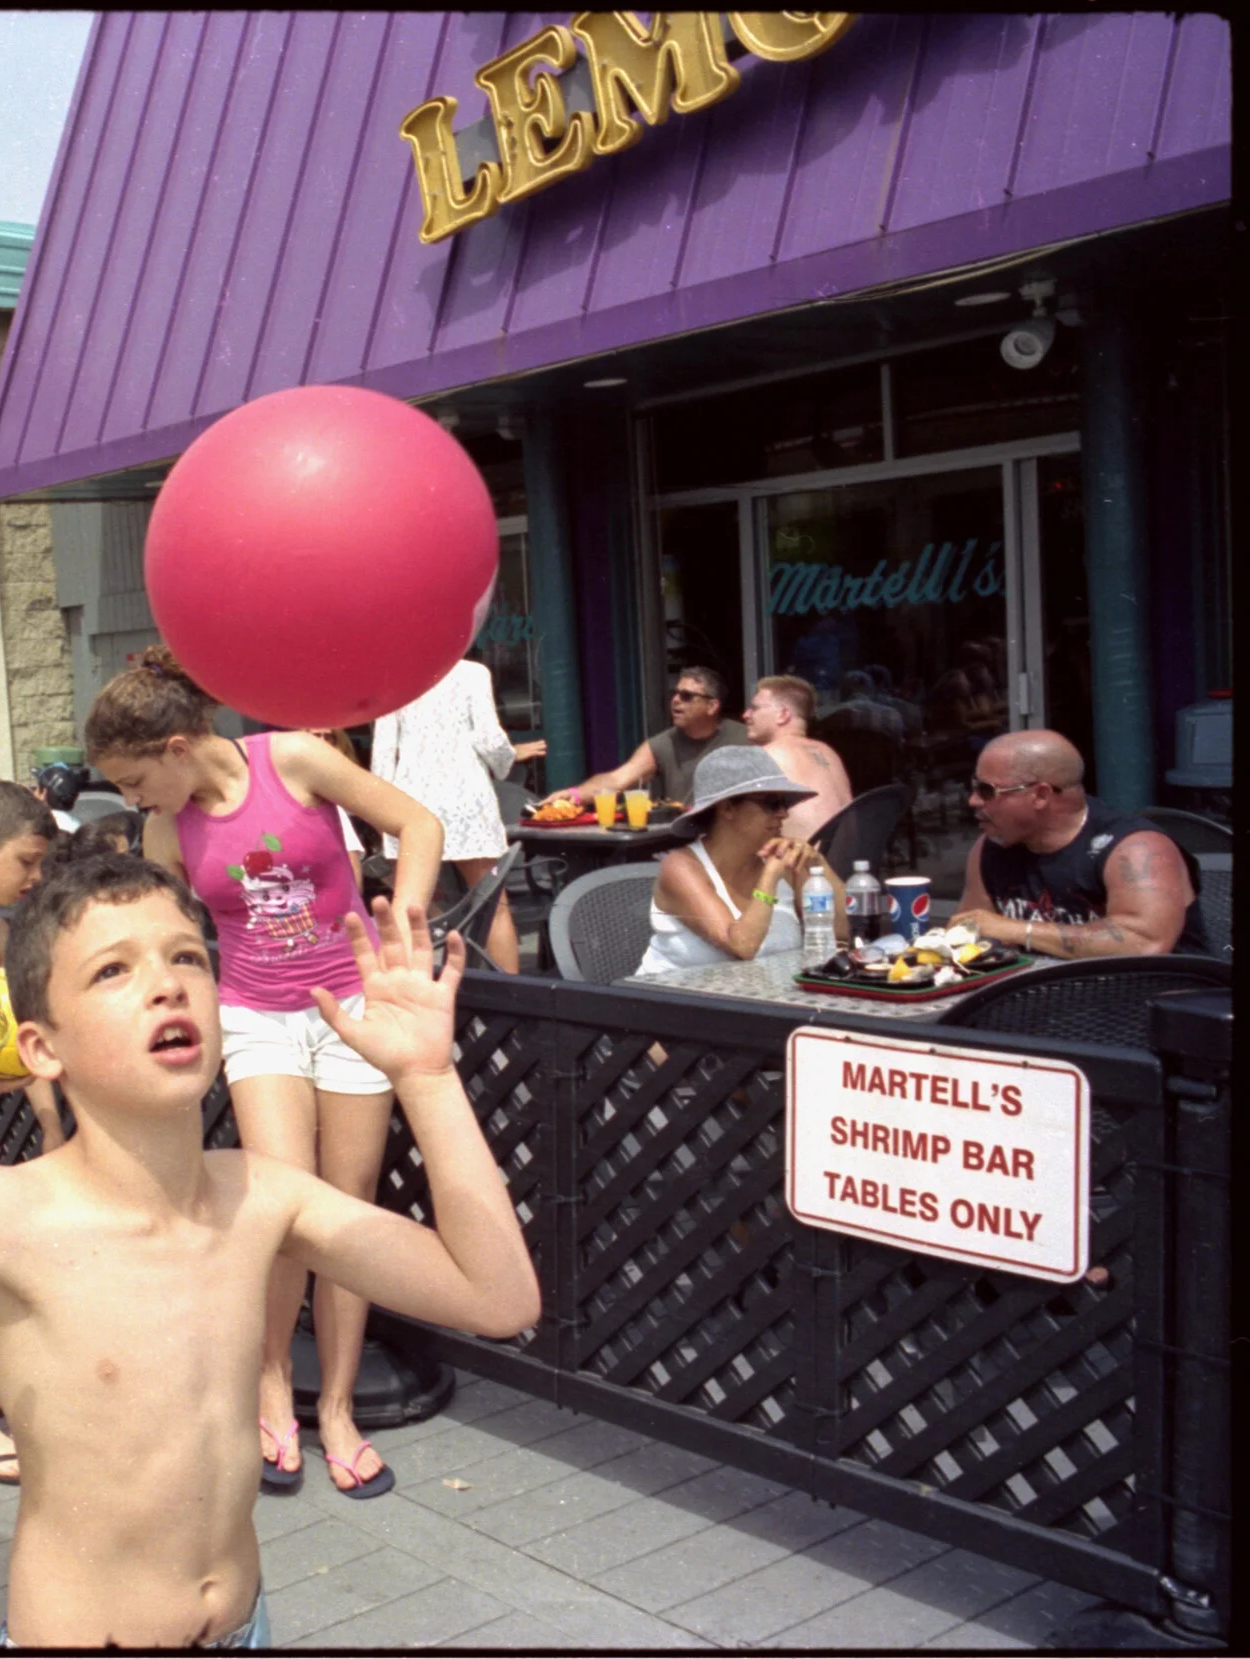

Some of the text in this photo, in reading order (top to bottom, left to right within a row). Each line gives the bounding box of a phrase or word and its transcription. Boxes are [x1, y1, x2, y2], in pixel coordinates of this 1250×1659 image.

[841, 1061, 1023, 1116] MARTELL'S
[830, 1116, 1035, 1181] SHRIMP BAR
[823, 1171, 1042, 1242] TABLES ONLY
